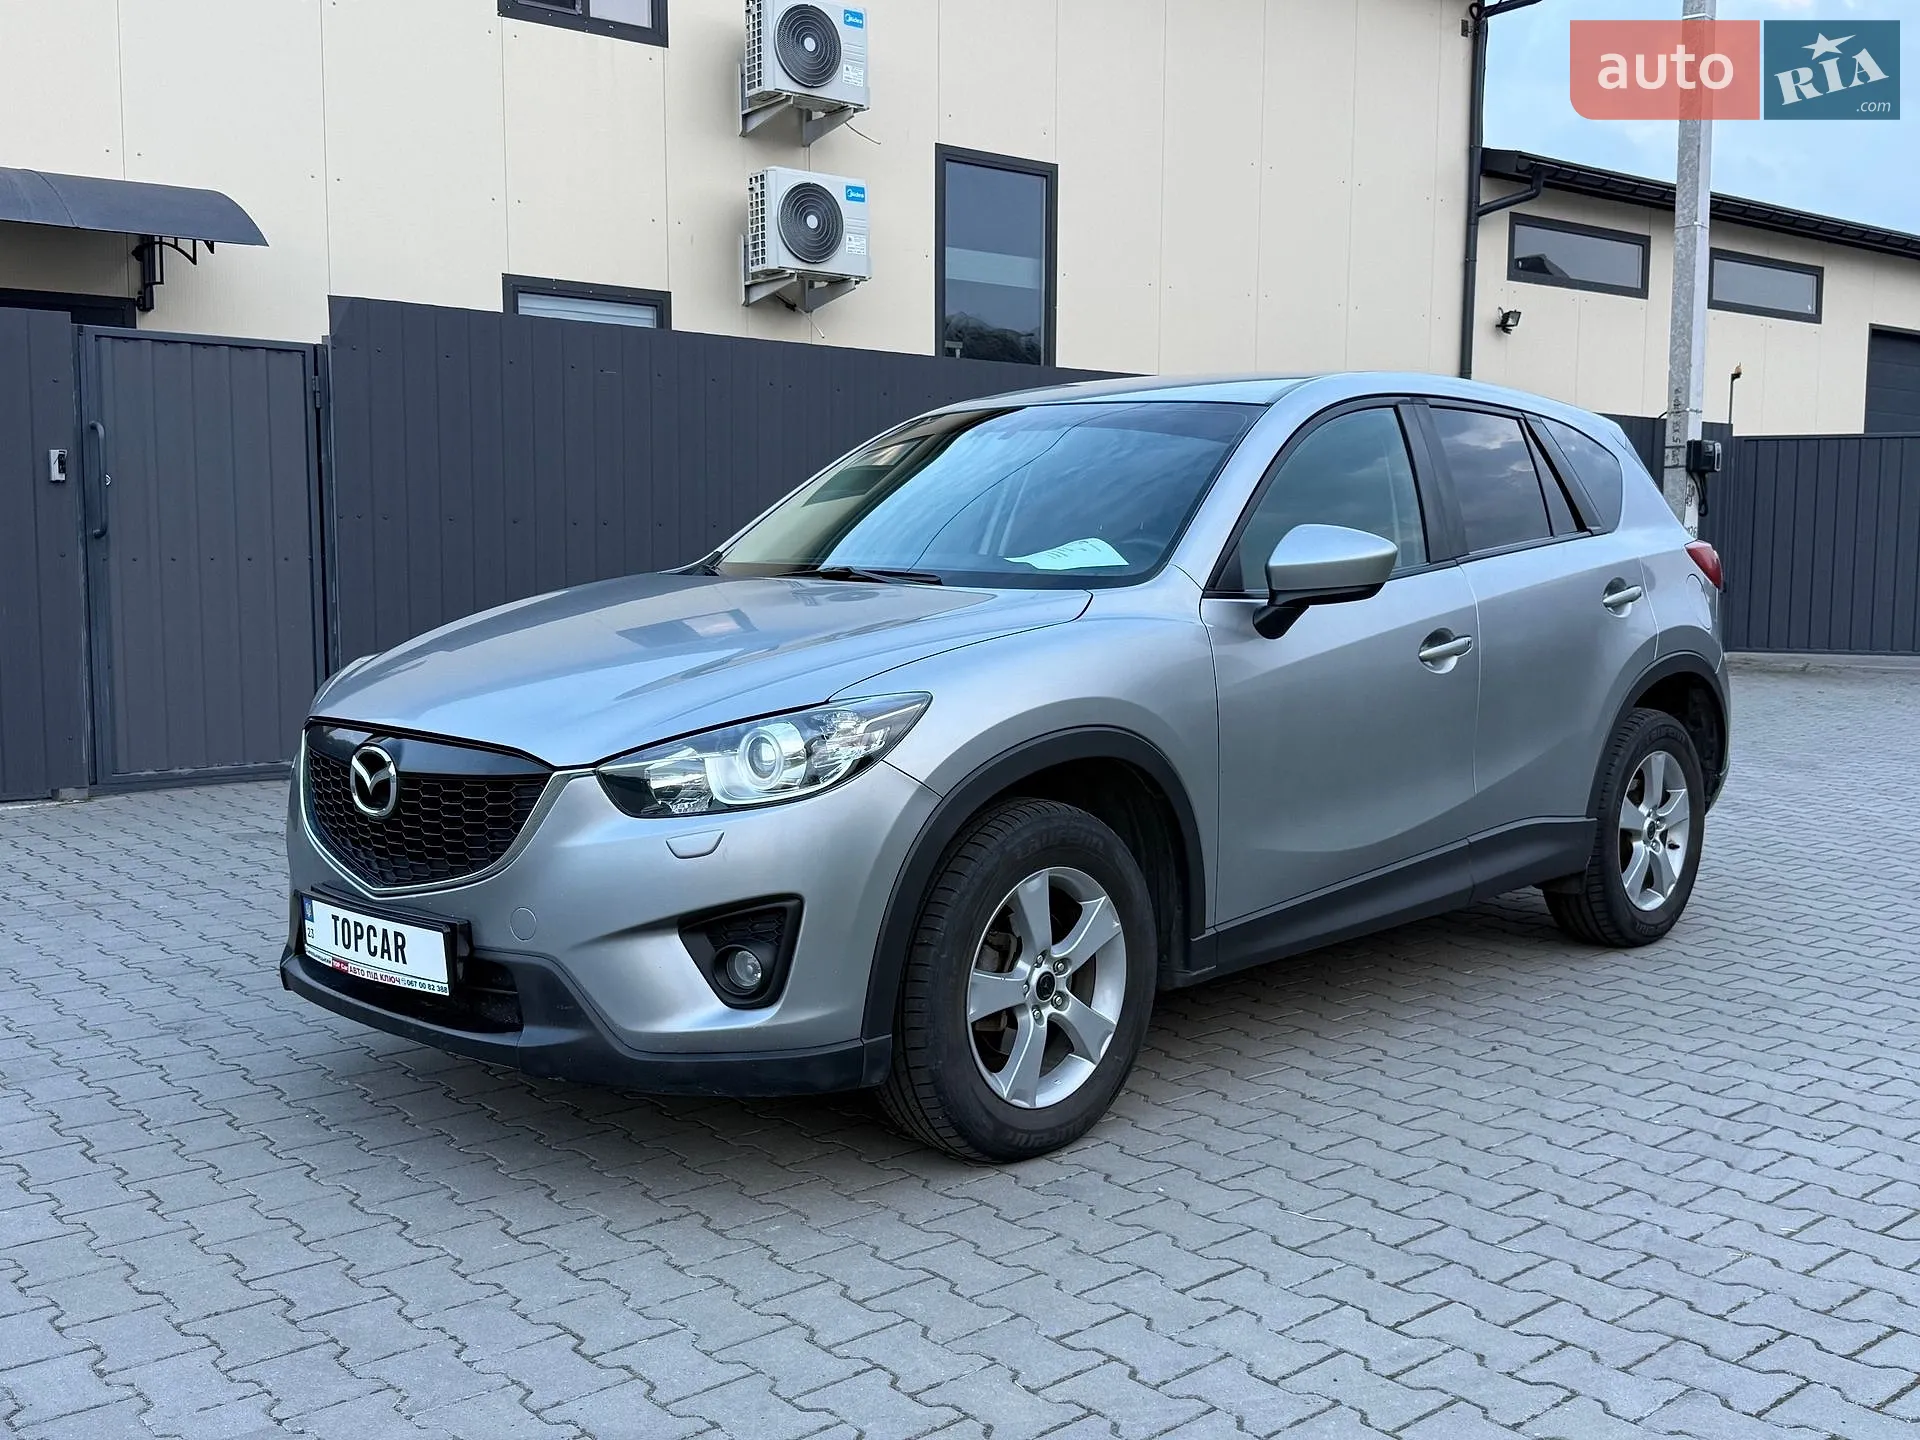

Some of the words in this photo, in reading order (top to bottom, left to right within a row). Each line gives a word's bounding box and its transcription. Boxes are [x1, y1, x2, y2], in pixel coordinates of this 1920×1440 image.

[331, 914, 408, 965] TOPCAR
[349, 966, 365, 977] АВТО
[380, 973, 401, 985] КЛЮЧ
